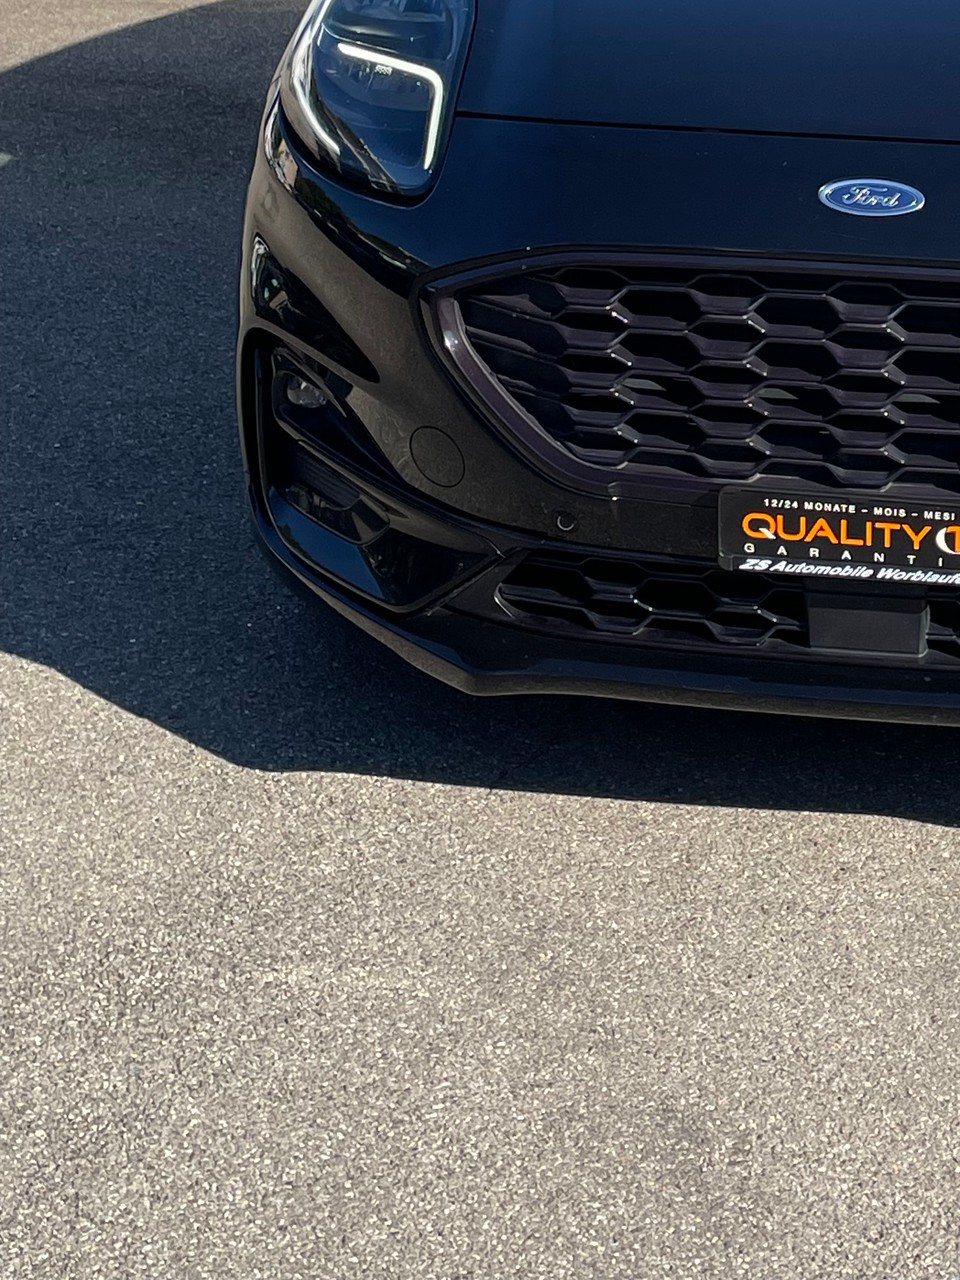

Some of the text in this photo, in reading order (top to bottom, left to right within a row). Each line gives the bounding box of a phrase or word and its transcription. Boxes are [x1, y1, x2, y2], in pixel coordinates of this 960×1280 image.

[842, 186, 901, 207] Ford
[763, 498, 799, 509] 12/24
[803, 501, 856, 513] MONATE
[873, 506, 906, 517] MOIS
[923, 510, 956, 521] MESI
[741, 512, 932, 551] QUALITY
[738, 558, 772, 570] ZS
[769, 560, 874, 578] Automobile
